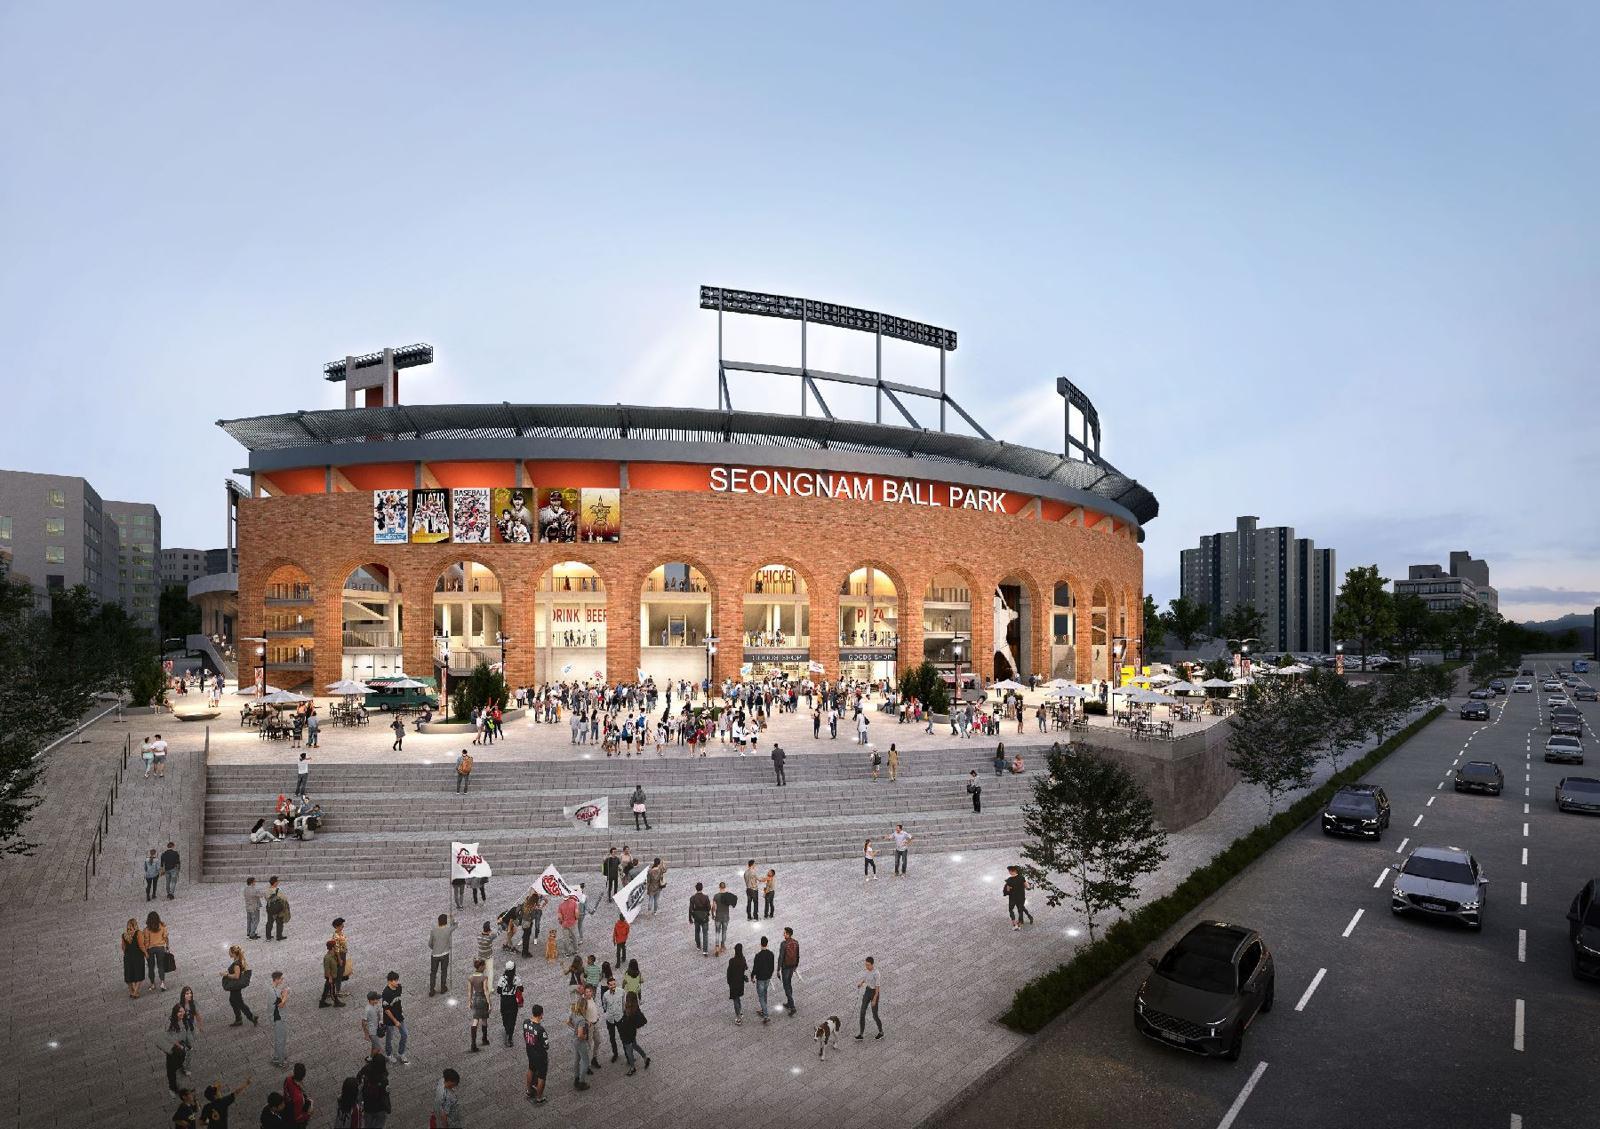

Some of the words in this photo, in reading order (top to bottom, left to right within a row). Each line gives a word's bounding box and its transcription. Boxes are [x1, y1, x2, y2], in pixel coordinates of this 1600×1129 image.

[709, 467, 873, 501] SEONGNAM
[882, 480, 941, 507] BALL
[949, 486, 1007, 513] PARK
